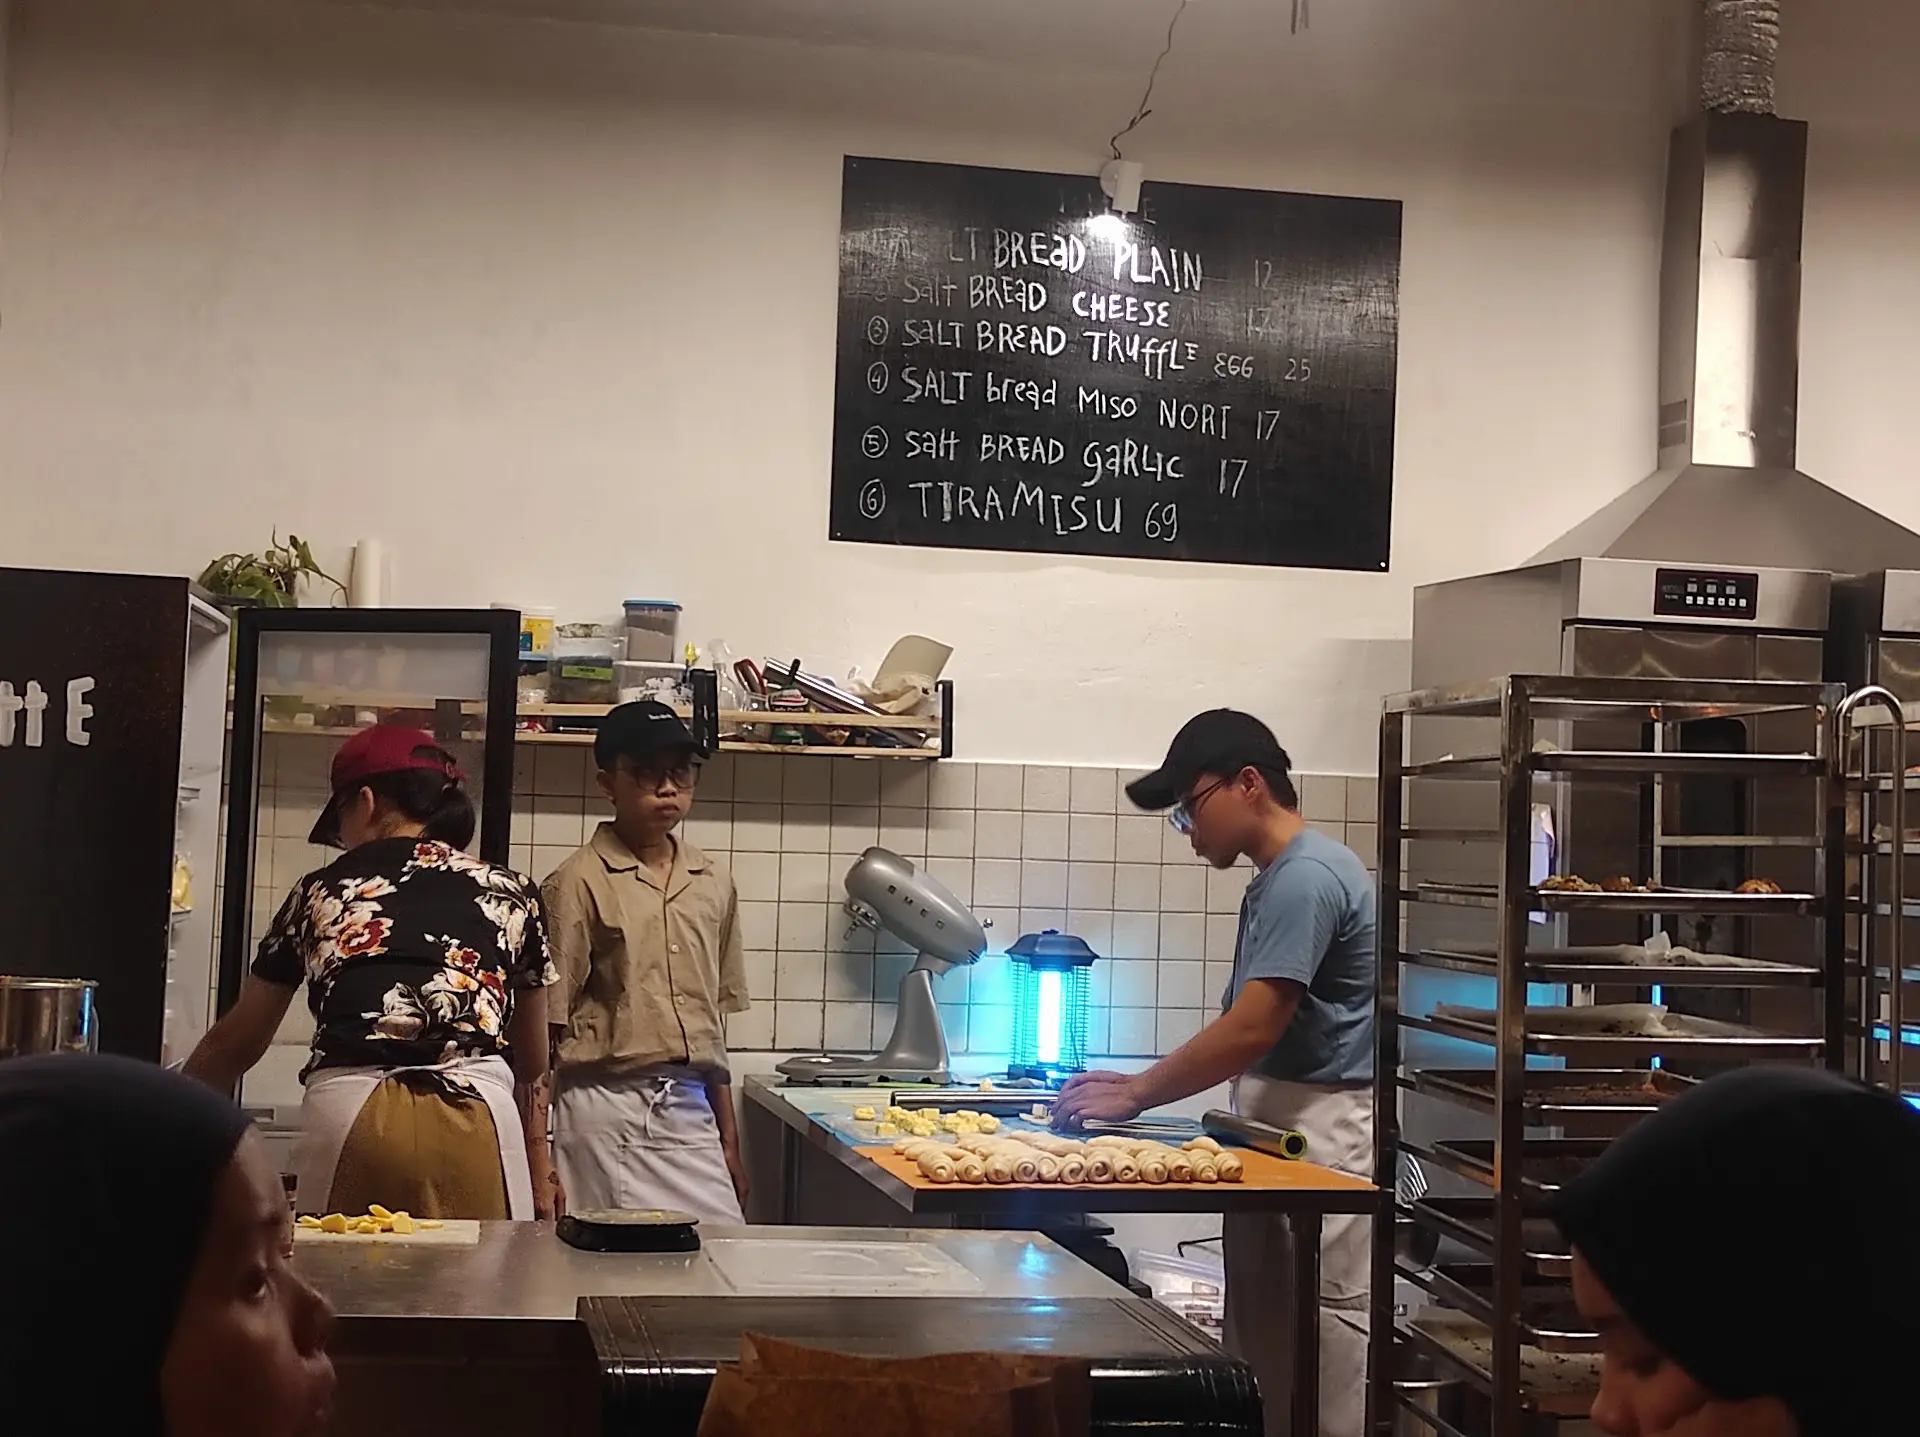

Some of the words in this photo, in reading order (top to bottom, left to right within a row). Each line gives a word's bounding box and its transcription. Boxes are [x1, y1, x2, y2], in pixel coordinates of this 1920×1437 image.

[1112, 237, 1202, 293] PLAIN
[1254, 259, 1279, 292] 12
[1072, 291, 1171, 328] CHEESE
[976, 320, 1067, 356] BREAD
[1213, 353, 1255, 379] EGG
[1284, 358, 1311, 382] 25
[901, 366, 973, 404] SALT
[986, 372, 1057, 410] bread
[1159, 398, 1231, 440] NORI
[1256, 410, 1281, 441] 17
[979, 433, 1065, 465] BREAD
[1219, 459, 1248, 498] 17
[908, 480, 1121, 535] TIRAMISU
[1144, 502, 1178, 542] 69
